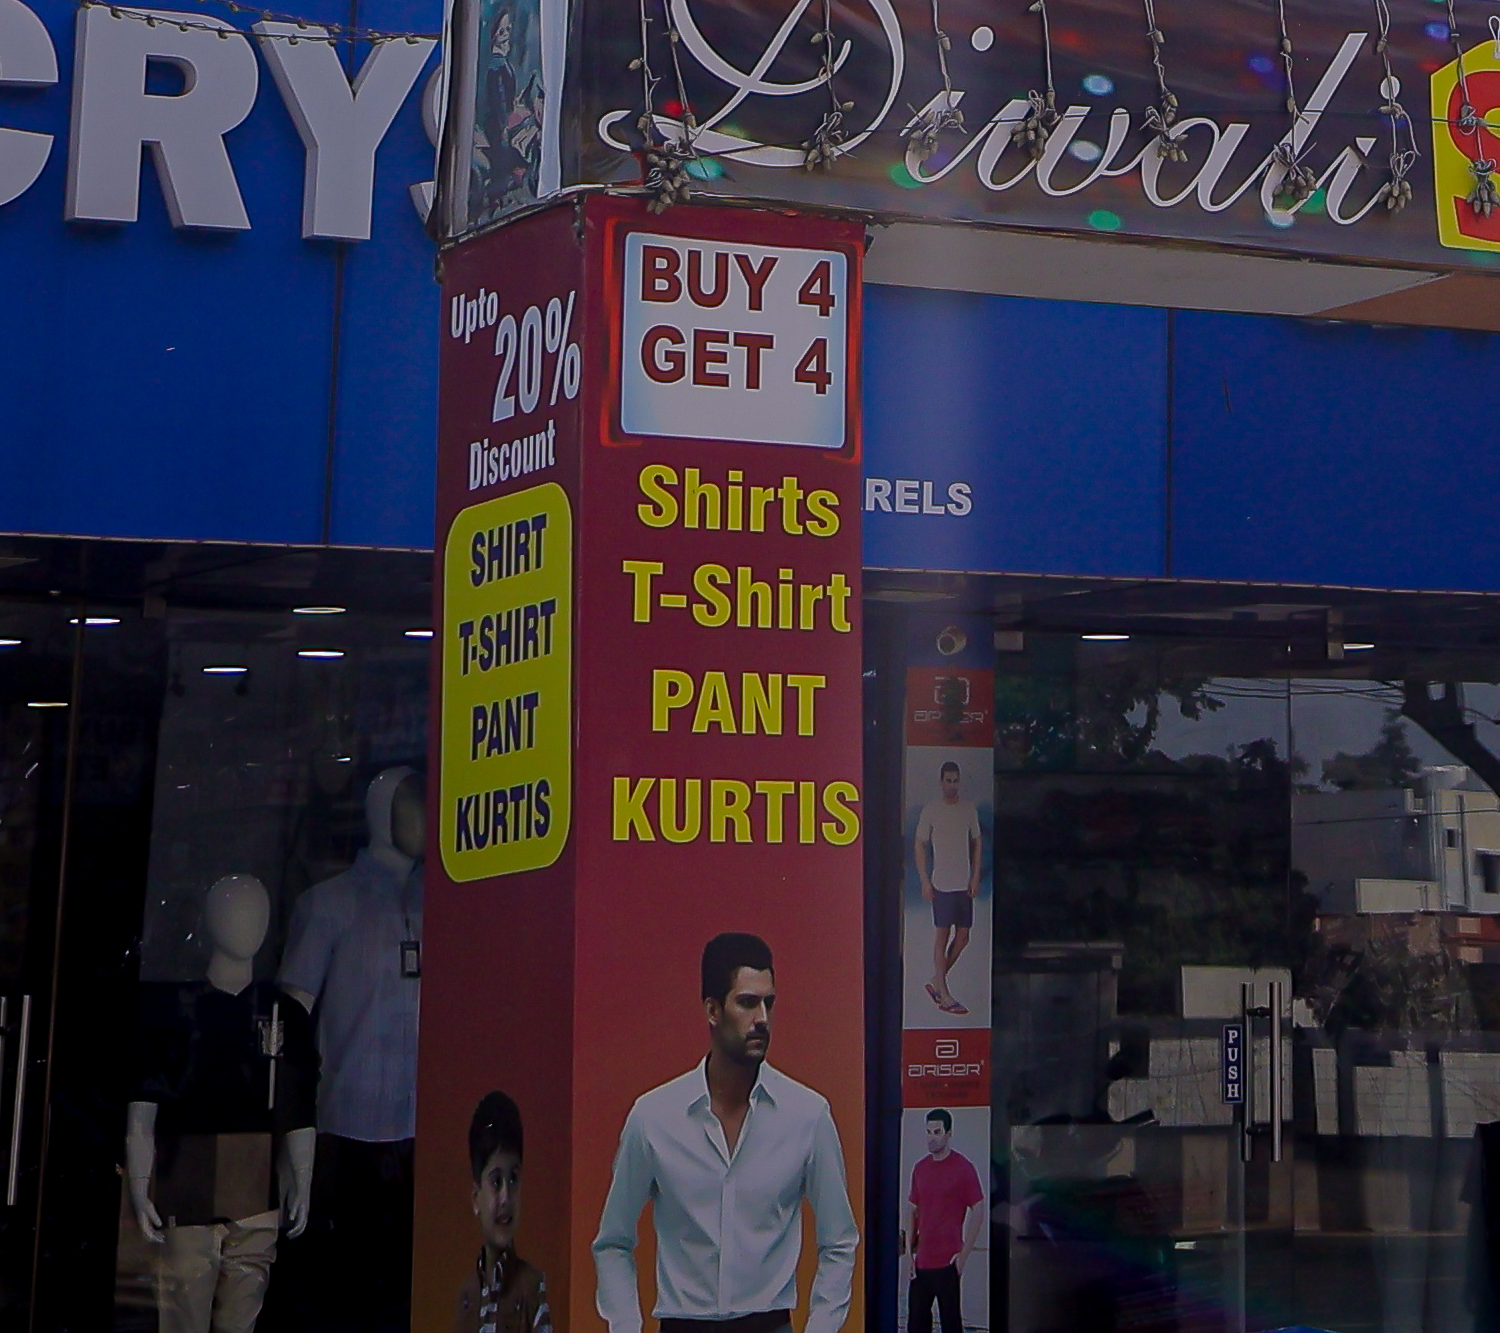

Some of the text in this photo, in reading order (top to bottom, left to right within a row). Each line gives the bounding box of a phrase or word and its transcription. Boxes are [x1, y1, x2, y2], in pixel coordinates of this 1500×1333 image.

[449, 287, 499, 344] Upto
[640, 244, 838, 318] BUY 4
[492, 290, 581, 423] 20%
[640, 322, 833, 395] GET 4
[468, 418, 557, 492] Discount
[636, 463, 841, 538] Shirts
[862, 477, 974, 517] RELS
[470, 512, 549, 589] SHIRT
[622, 559, 853, 633] T-Shirt
[458, 597, 557, 676] T-SHIRT
[470, 690, 540, 762] PANT
[650, 669, 827, 736] PANT
[455, 778, 552, 854] KURTIS
[611, 776, 861, 847] KURTIS
[1224, 1026, 1241, 1104] PUSH
